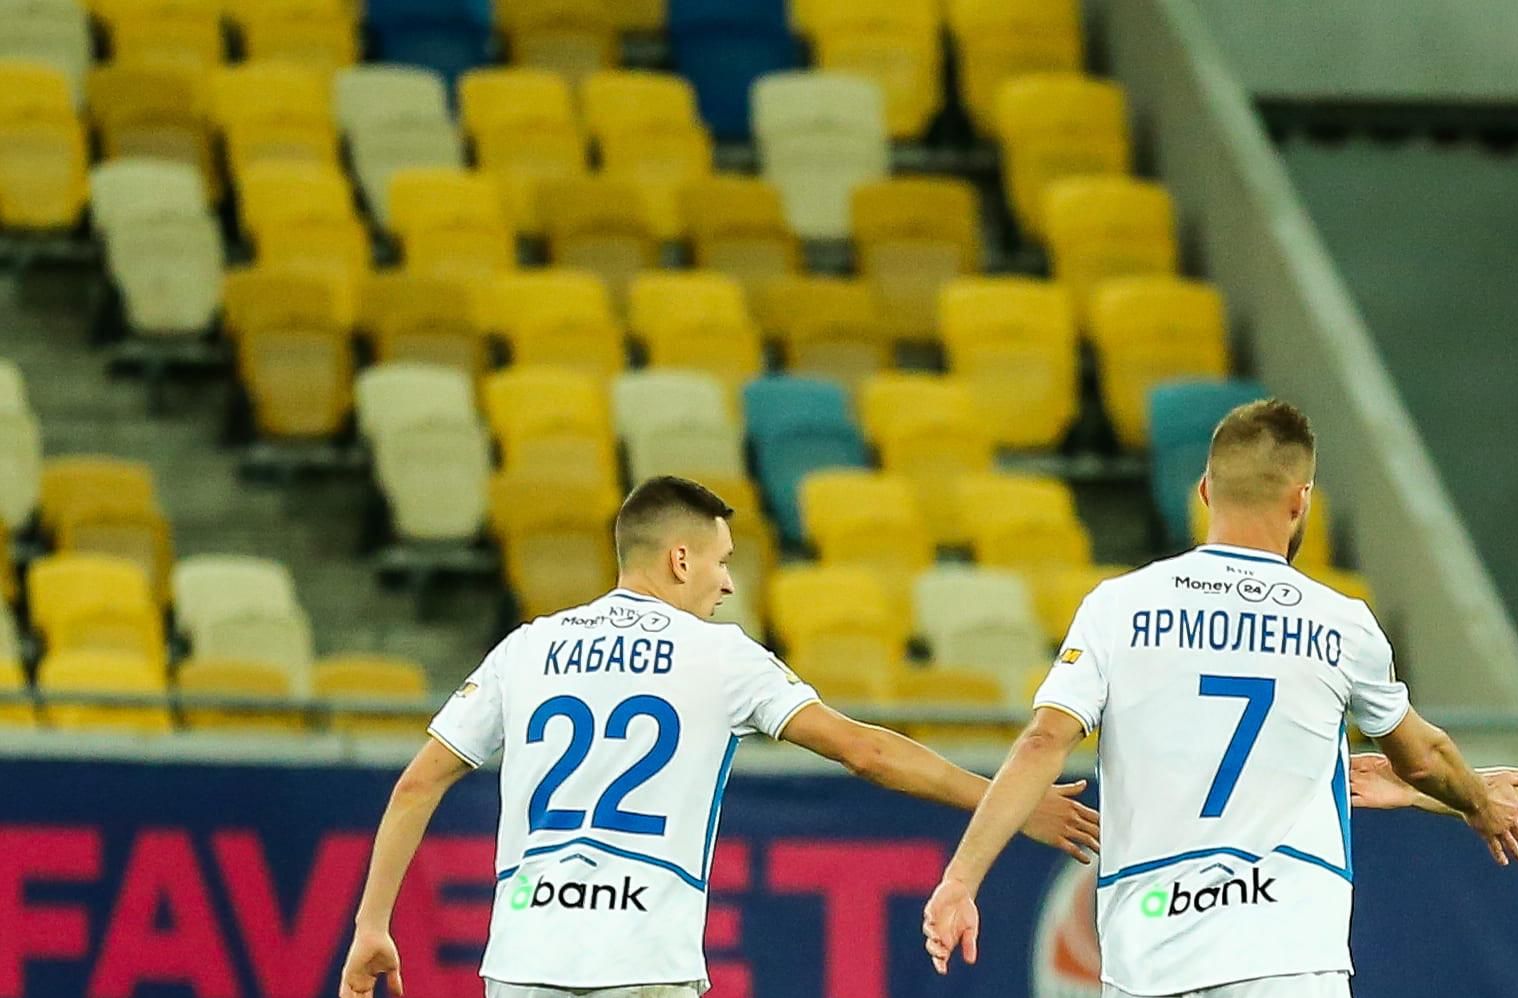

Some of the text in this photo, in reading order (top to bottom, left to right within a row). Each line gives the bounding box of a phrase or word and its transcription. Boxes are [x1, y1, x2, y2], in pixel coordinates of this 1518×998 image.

[1175, 576, 1233, 594] Money
[543, 636, 675, 676] КАБАЄВ
[1131, 608, 1343, 667] ЯРМОЛЕНКО
[526, 694, 681, 837] 22
[1199, 674, 1277, 818] 7
